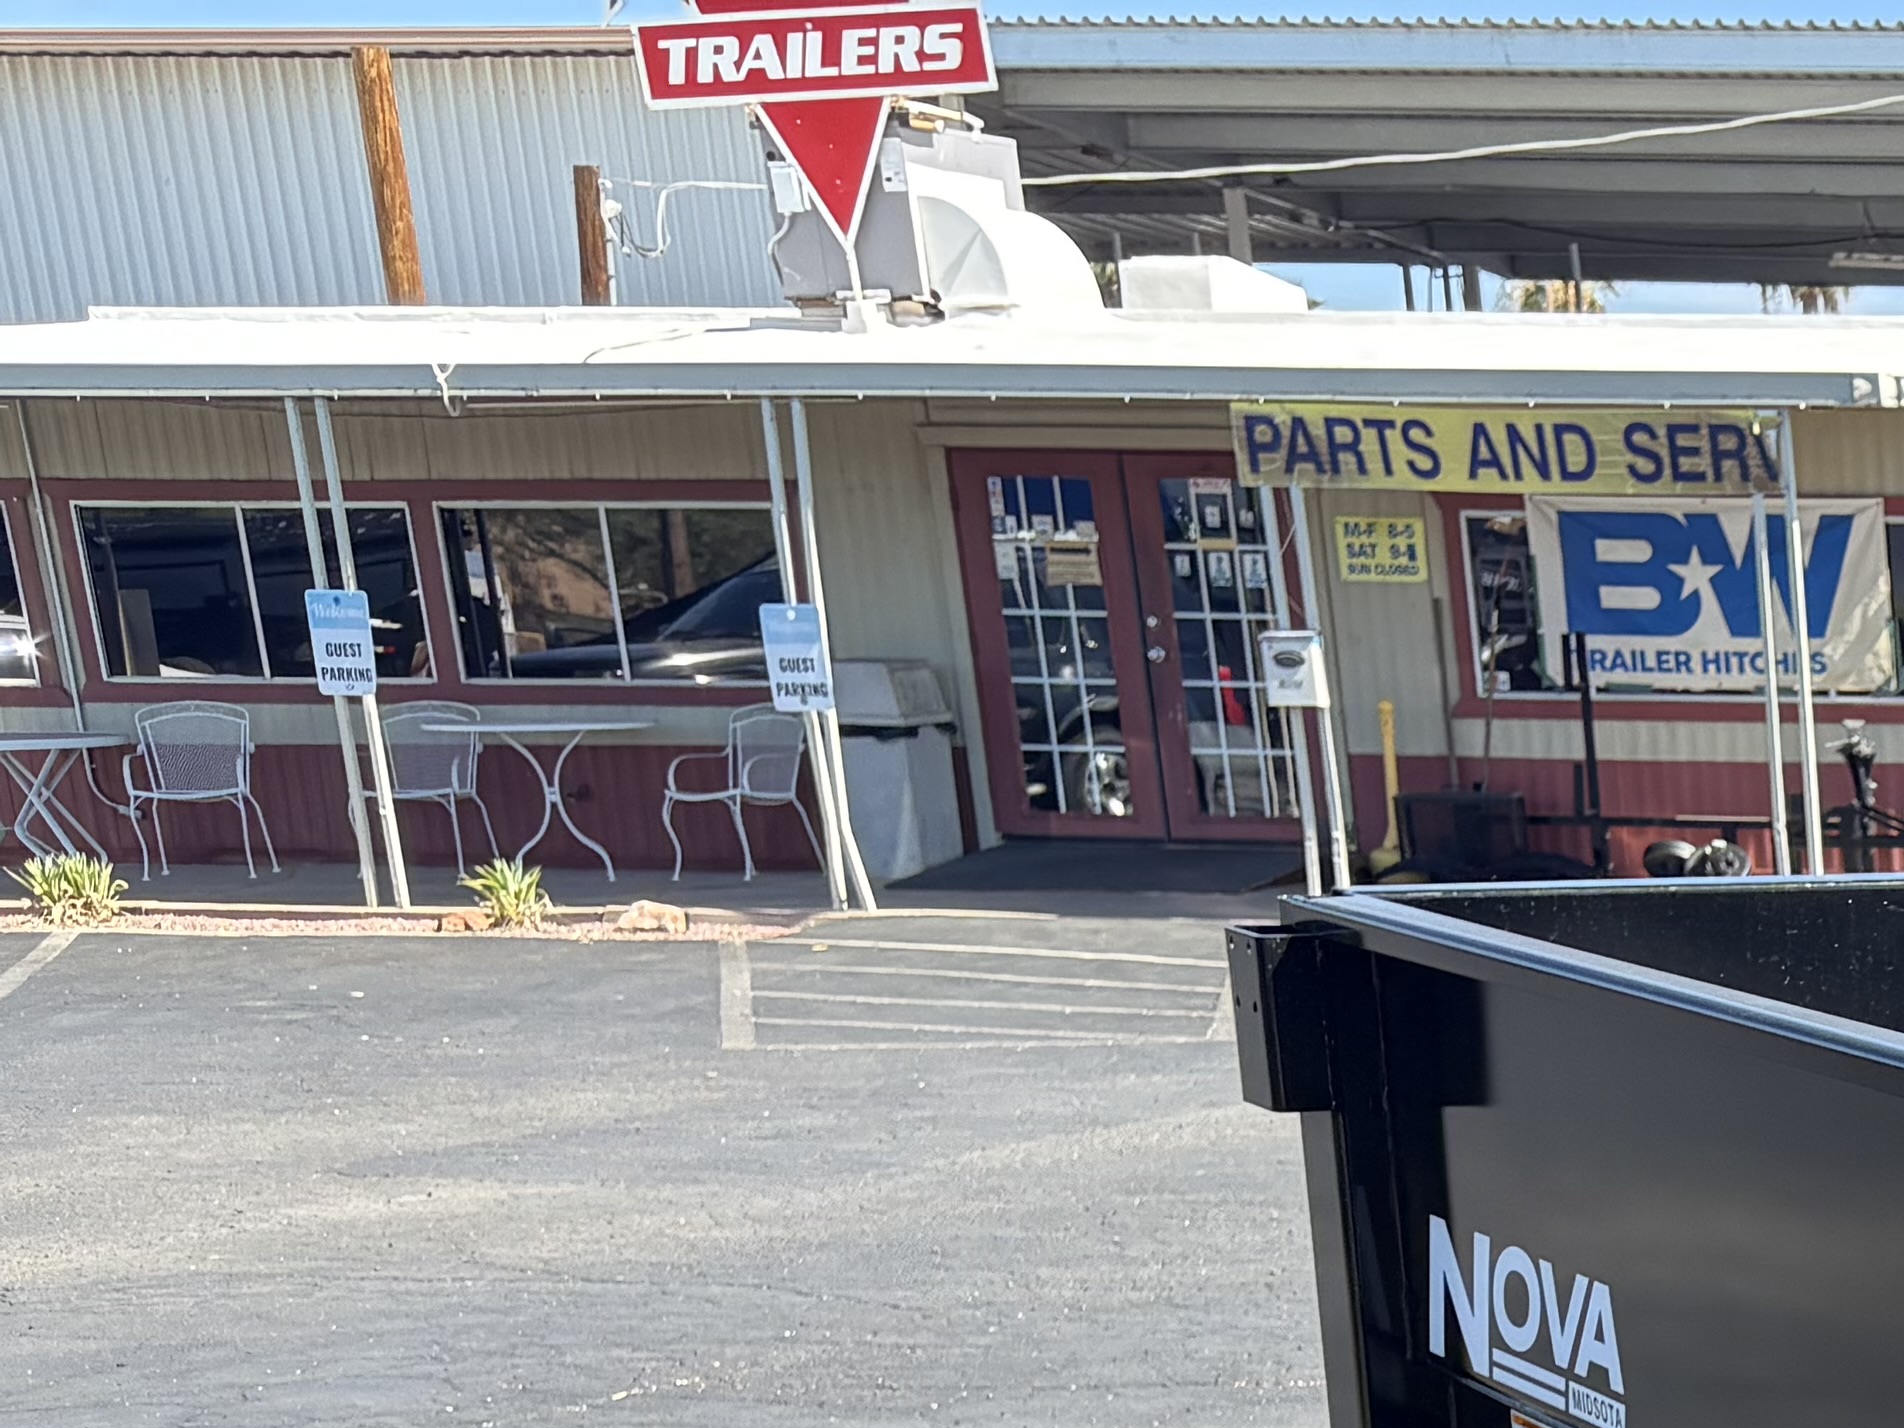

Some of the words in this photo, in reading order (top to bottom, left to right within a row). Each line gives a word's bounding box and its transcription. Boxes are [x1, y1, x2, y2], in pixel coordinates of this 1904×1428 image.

[657, 22, 964, 86] TRAILERS
[1243, 414, 1443, 480] PARTS
[1467, 421, 1598, 483] AND
[1346, 542, 1377, 560] SAT
[325, 642, 362, 659] GUEST
[778, 657, 816, 674] GUEST
[1569, 648, 1695, 674] RAILER
[320, 666, 374, 684] PARKING
[775, 682, 829, 698] PARKING
[1429, 1213, 1625, 1396] NOVA
